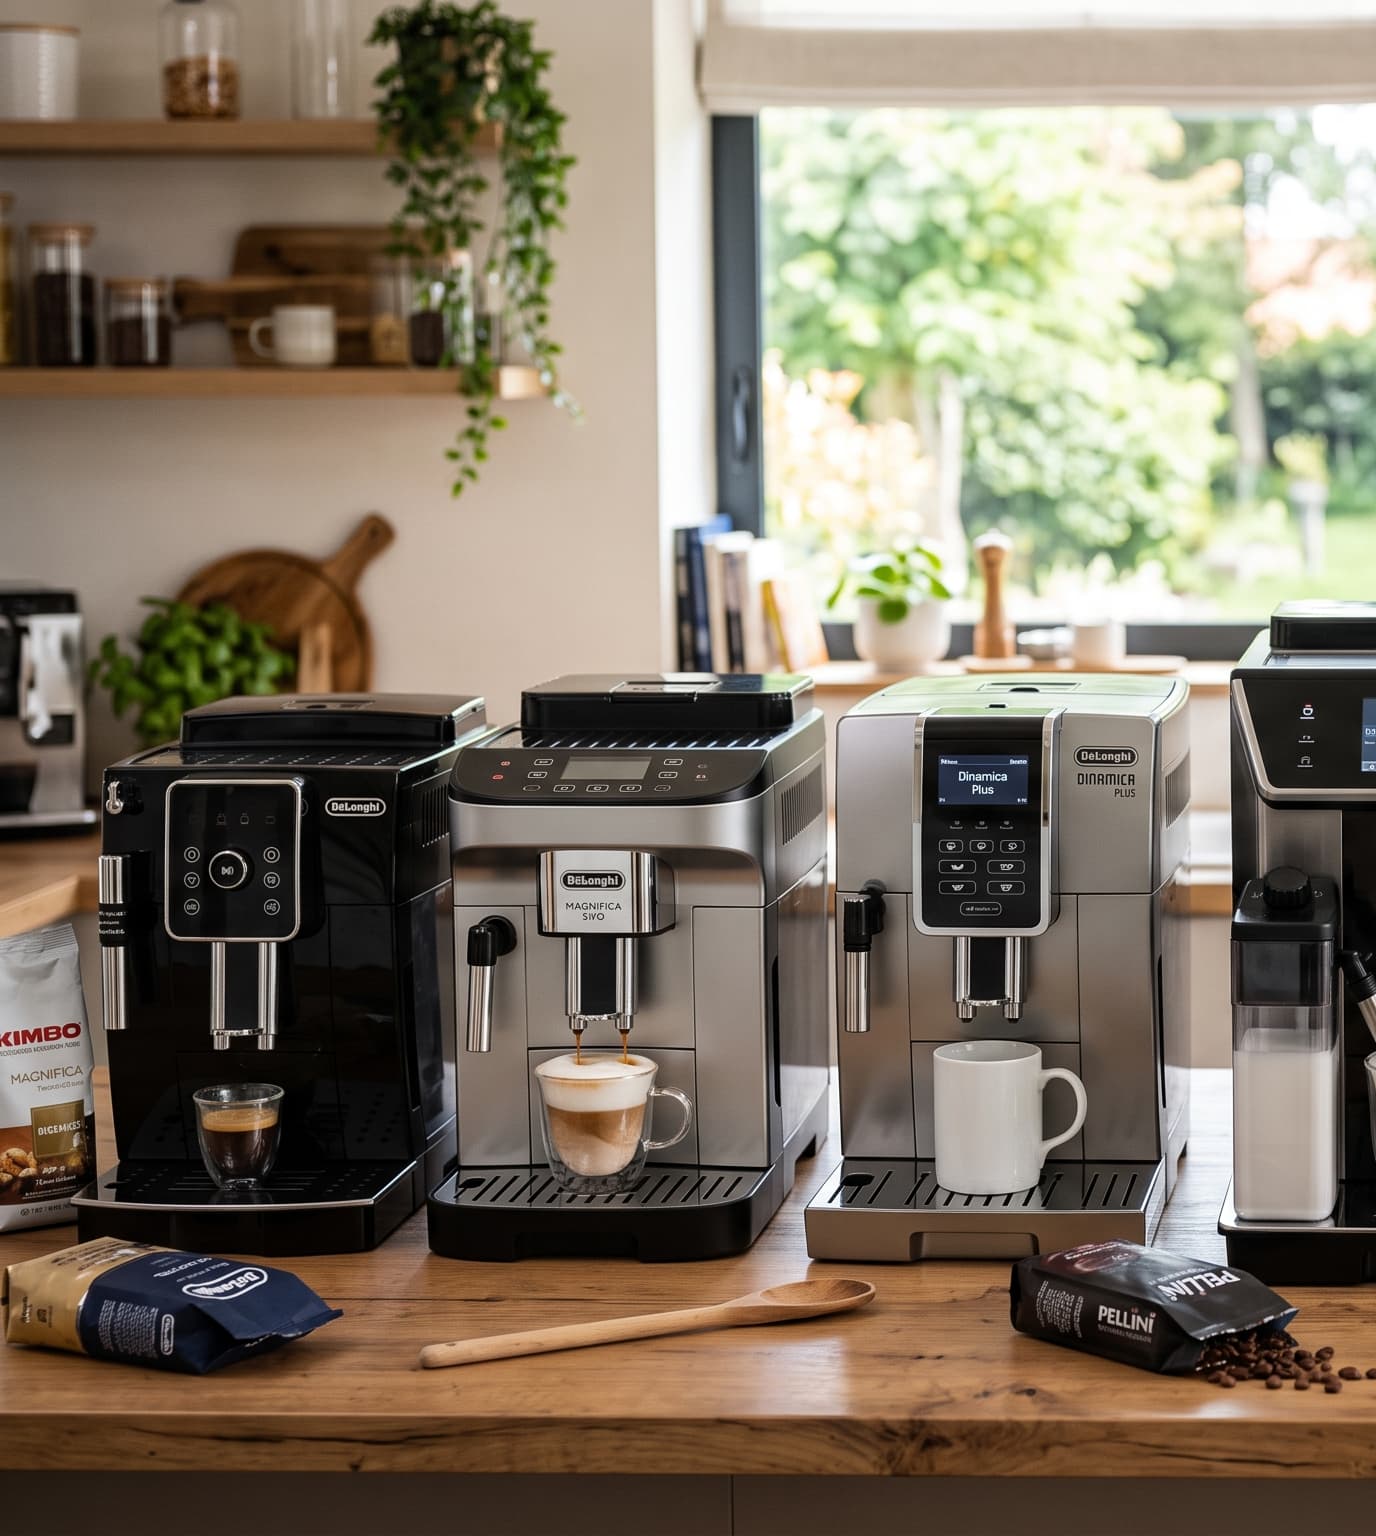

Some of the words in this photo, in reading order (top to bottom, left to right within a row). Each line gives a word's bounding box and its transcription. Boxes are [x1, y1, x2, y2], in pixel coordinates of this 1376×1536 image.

[958, 771, 1008, 782] Dinamica
[972, 784, 995, 795] Plus
[1114, 788, 1136, 798] PLUS
[565, 902, 622, 911] MAGNIFICA
[0, 1023, 81, 1047] KIMBO
[11, 1065, 84, 1084] MAGNIFICA
